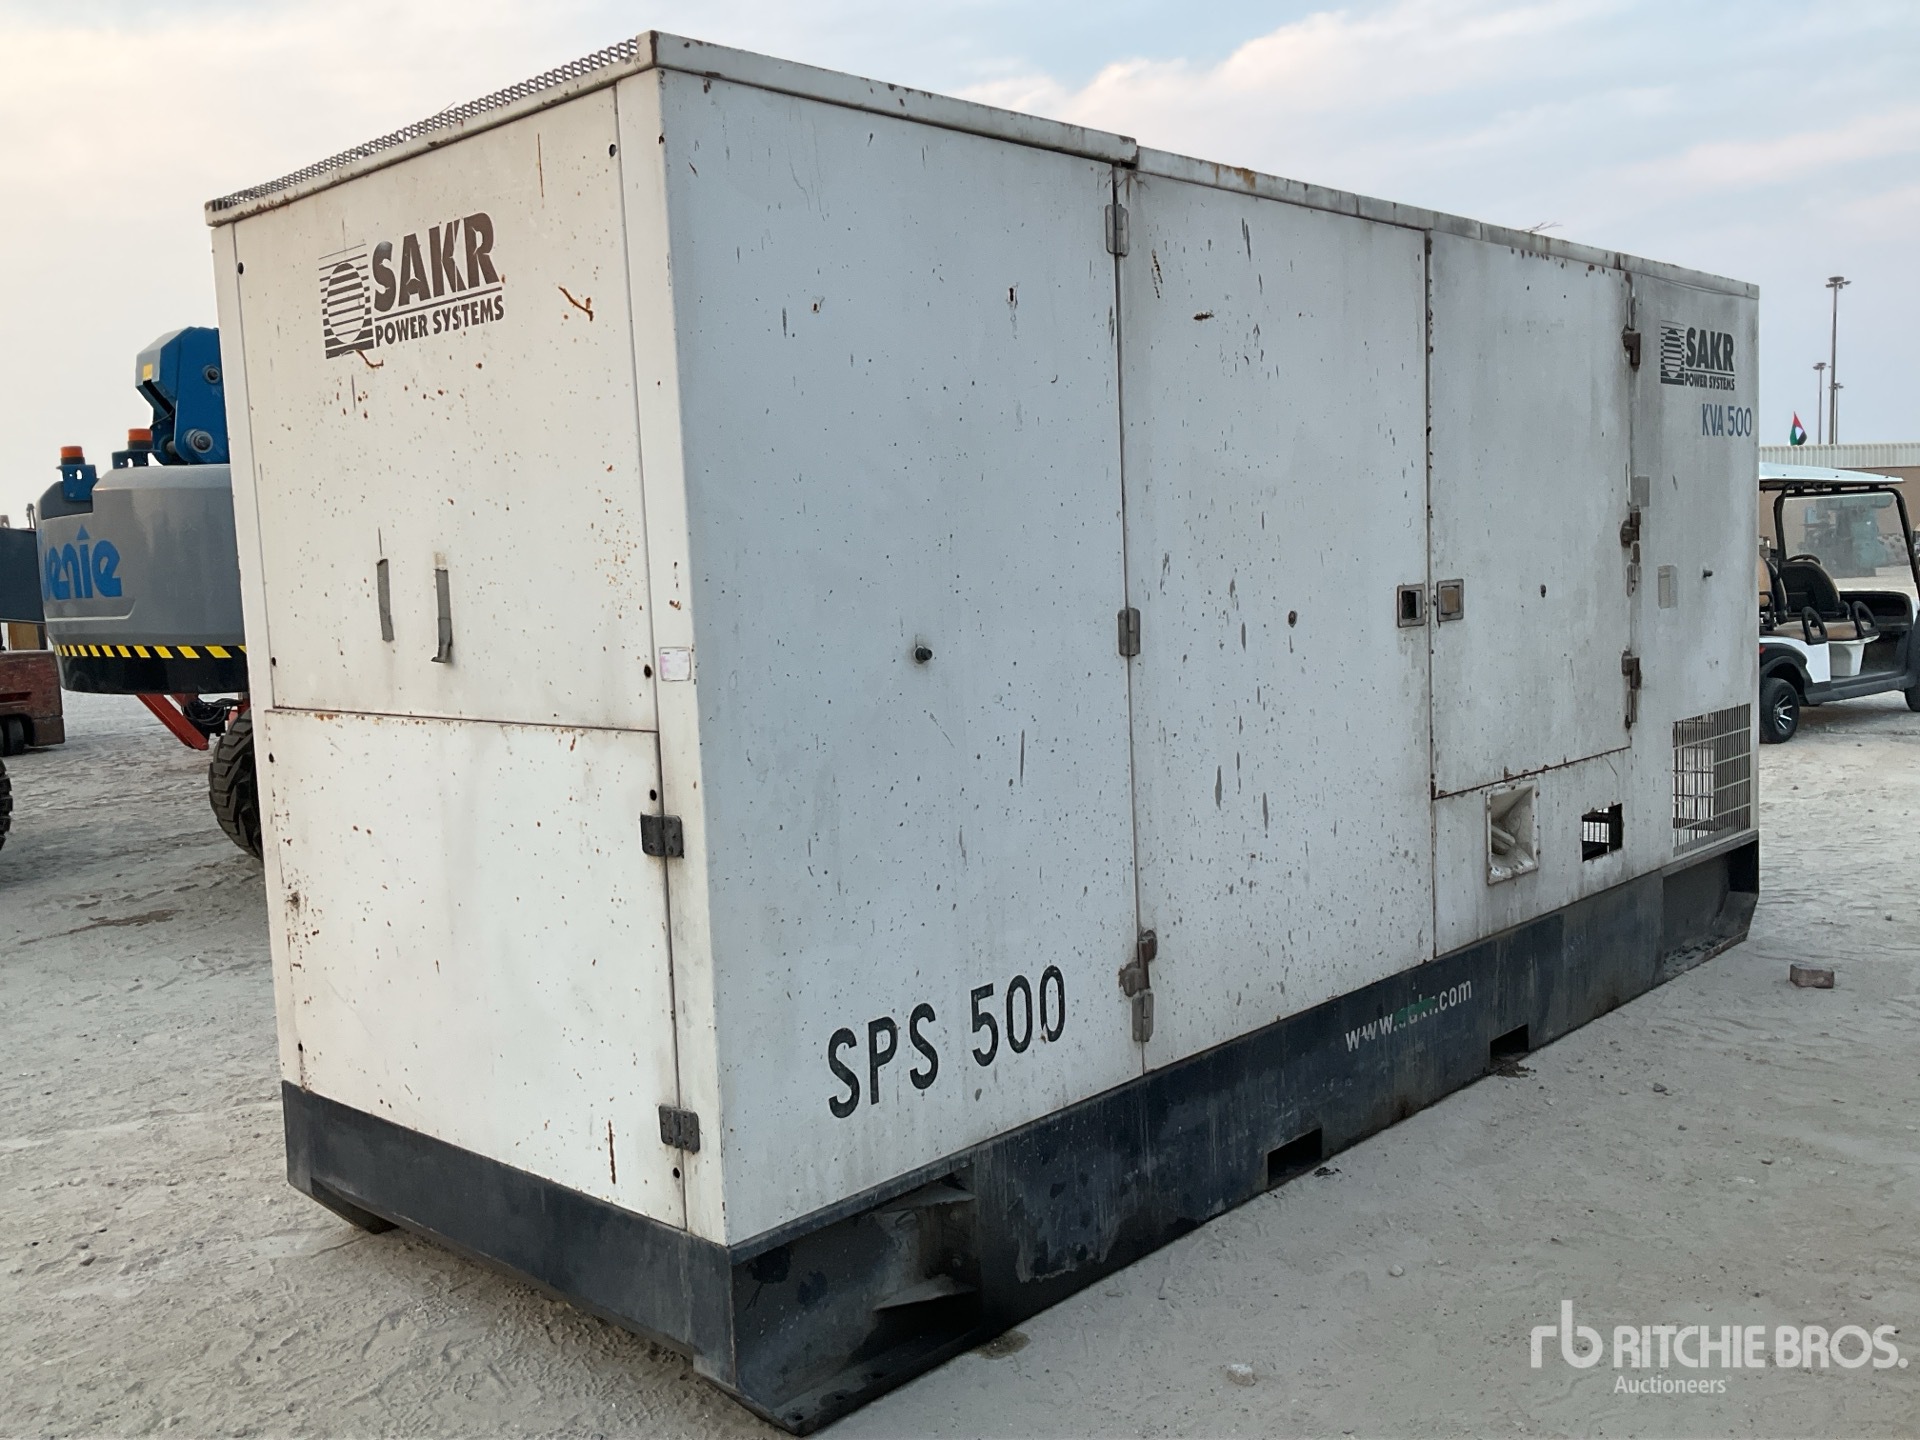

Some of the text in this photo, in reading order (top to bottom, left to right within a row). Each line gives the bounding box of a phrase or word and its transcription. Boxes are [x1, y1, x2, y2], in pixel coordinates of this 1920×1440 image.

[372, 213, 500, 313] SAKR
[375, 295, 504, 347] POWER SYSTEMS
[1685, 327, 1734, 372] SAKR
[1685, 372, 1735, 391] POWER SYSTEMS
[1702, 403, 1752, 437] KVA 500
[828, 964, 1066, 1119] SPS 500
